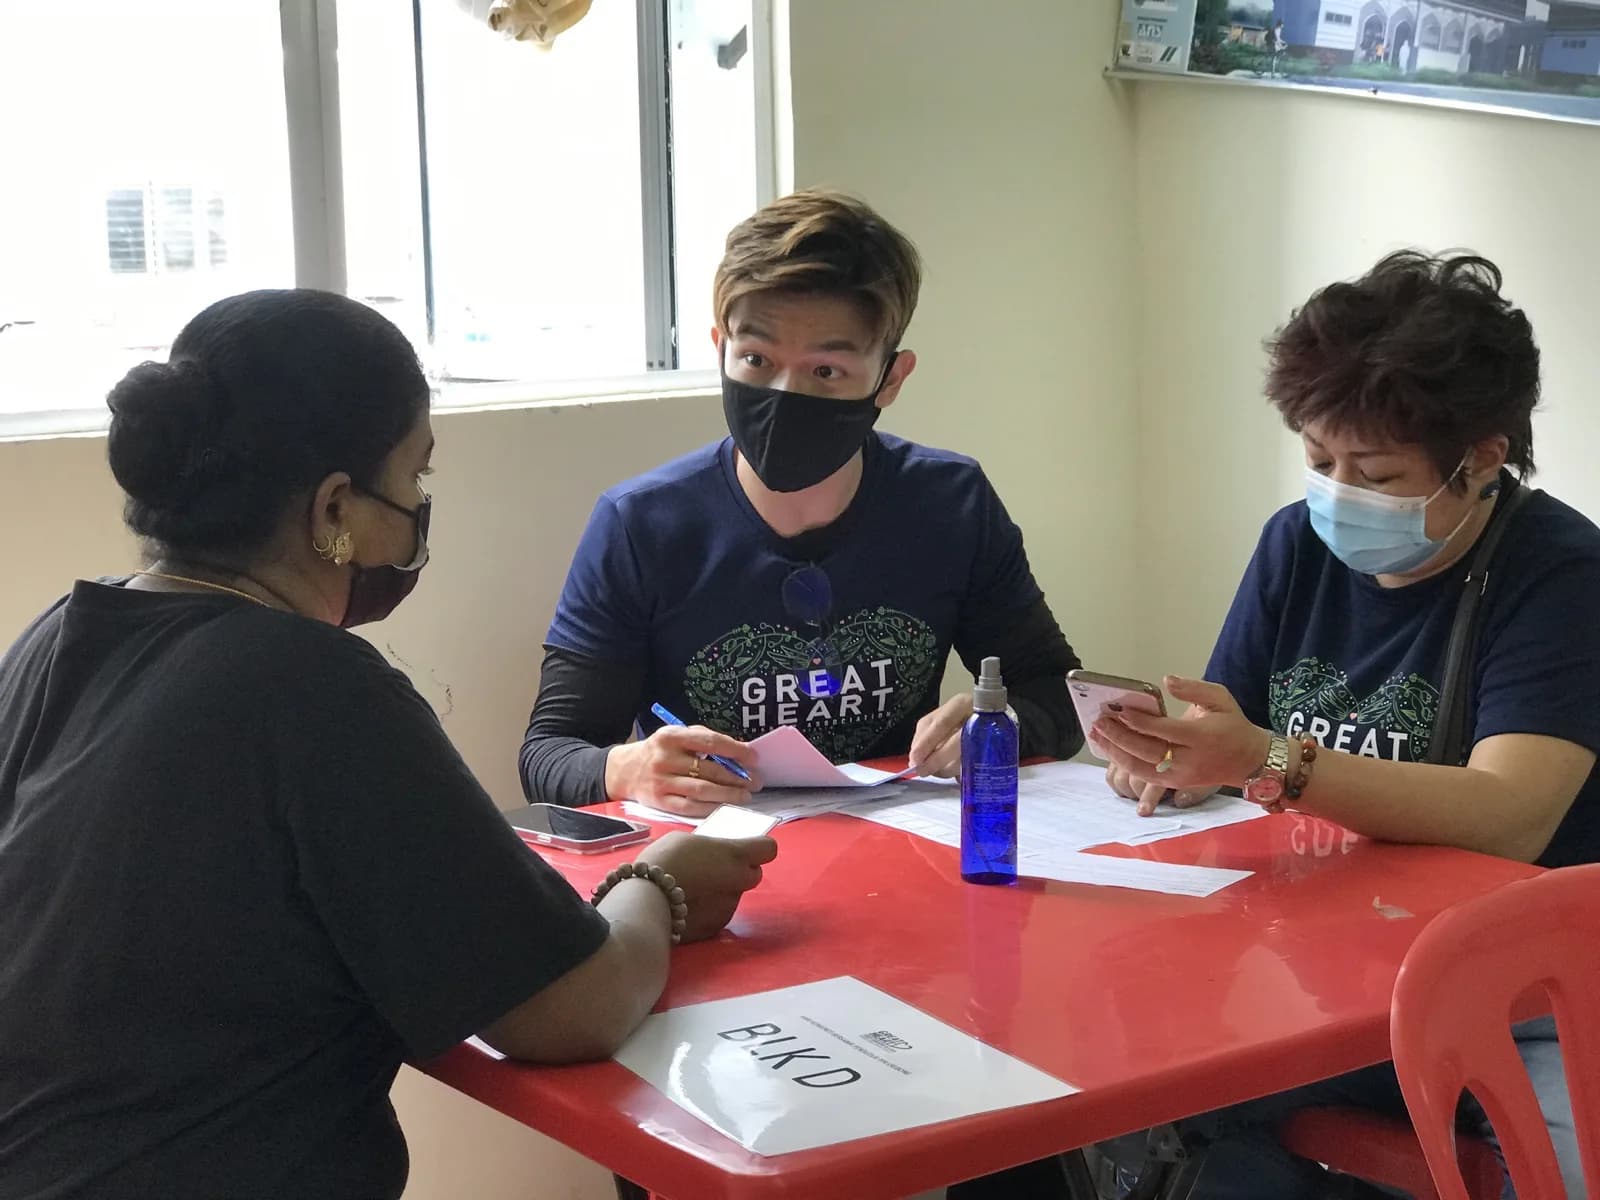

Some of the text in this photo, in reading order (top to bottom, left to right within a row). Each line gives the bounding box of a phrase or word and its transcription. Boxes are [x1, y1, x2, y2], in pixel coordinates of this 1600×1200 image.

[741, 658, 893, 705] GREAT
[741, 687, 894, 728] HEART
[1286, 711, 1408, 762] GREAT
[791, 1066, 862, 1088] D
